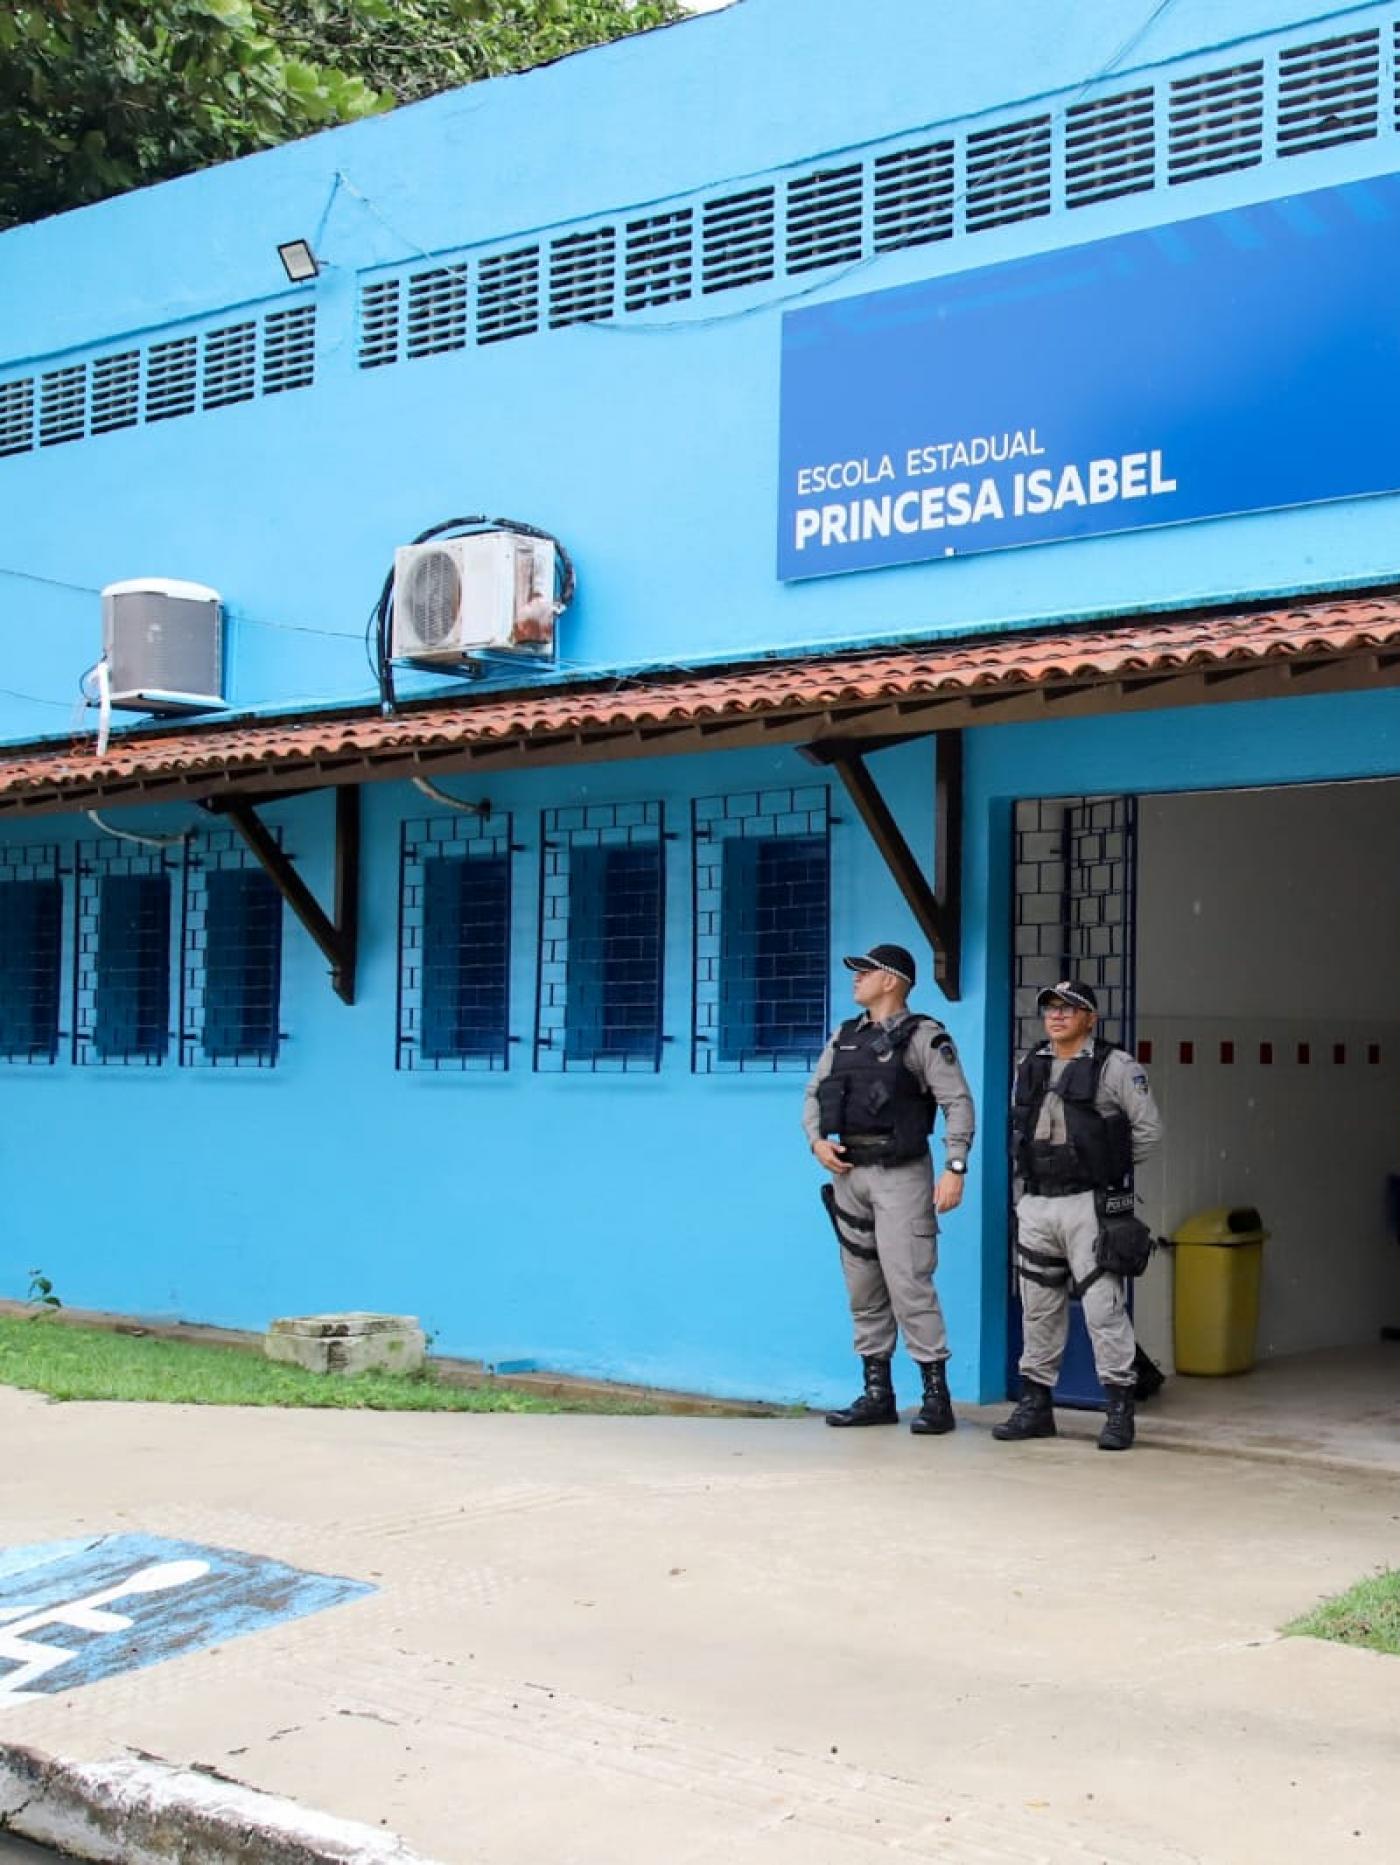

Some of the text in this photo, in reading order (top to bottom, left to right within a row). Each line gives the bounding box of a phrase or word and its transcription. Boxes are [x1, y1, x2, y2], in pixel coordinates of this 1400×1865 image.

[796, 450, 1176, 550] PRINCESA ISABEL
[797, 428, 1045, 495] ESCOLA ESTADUAL
